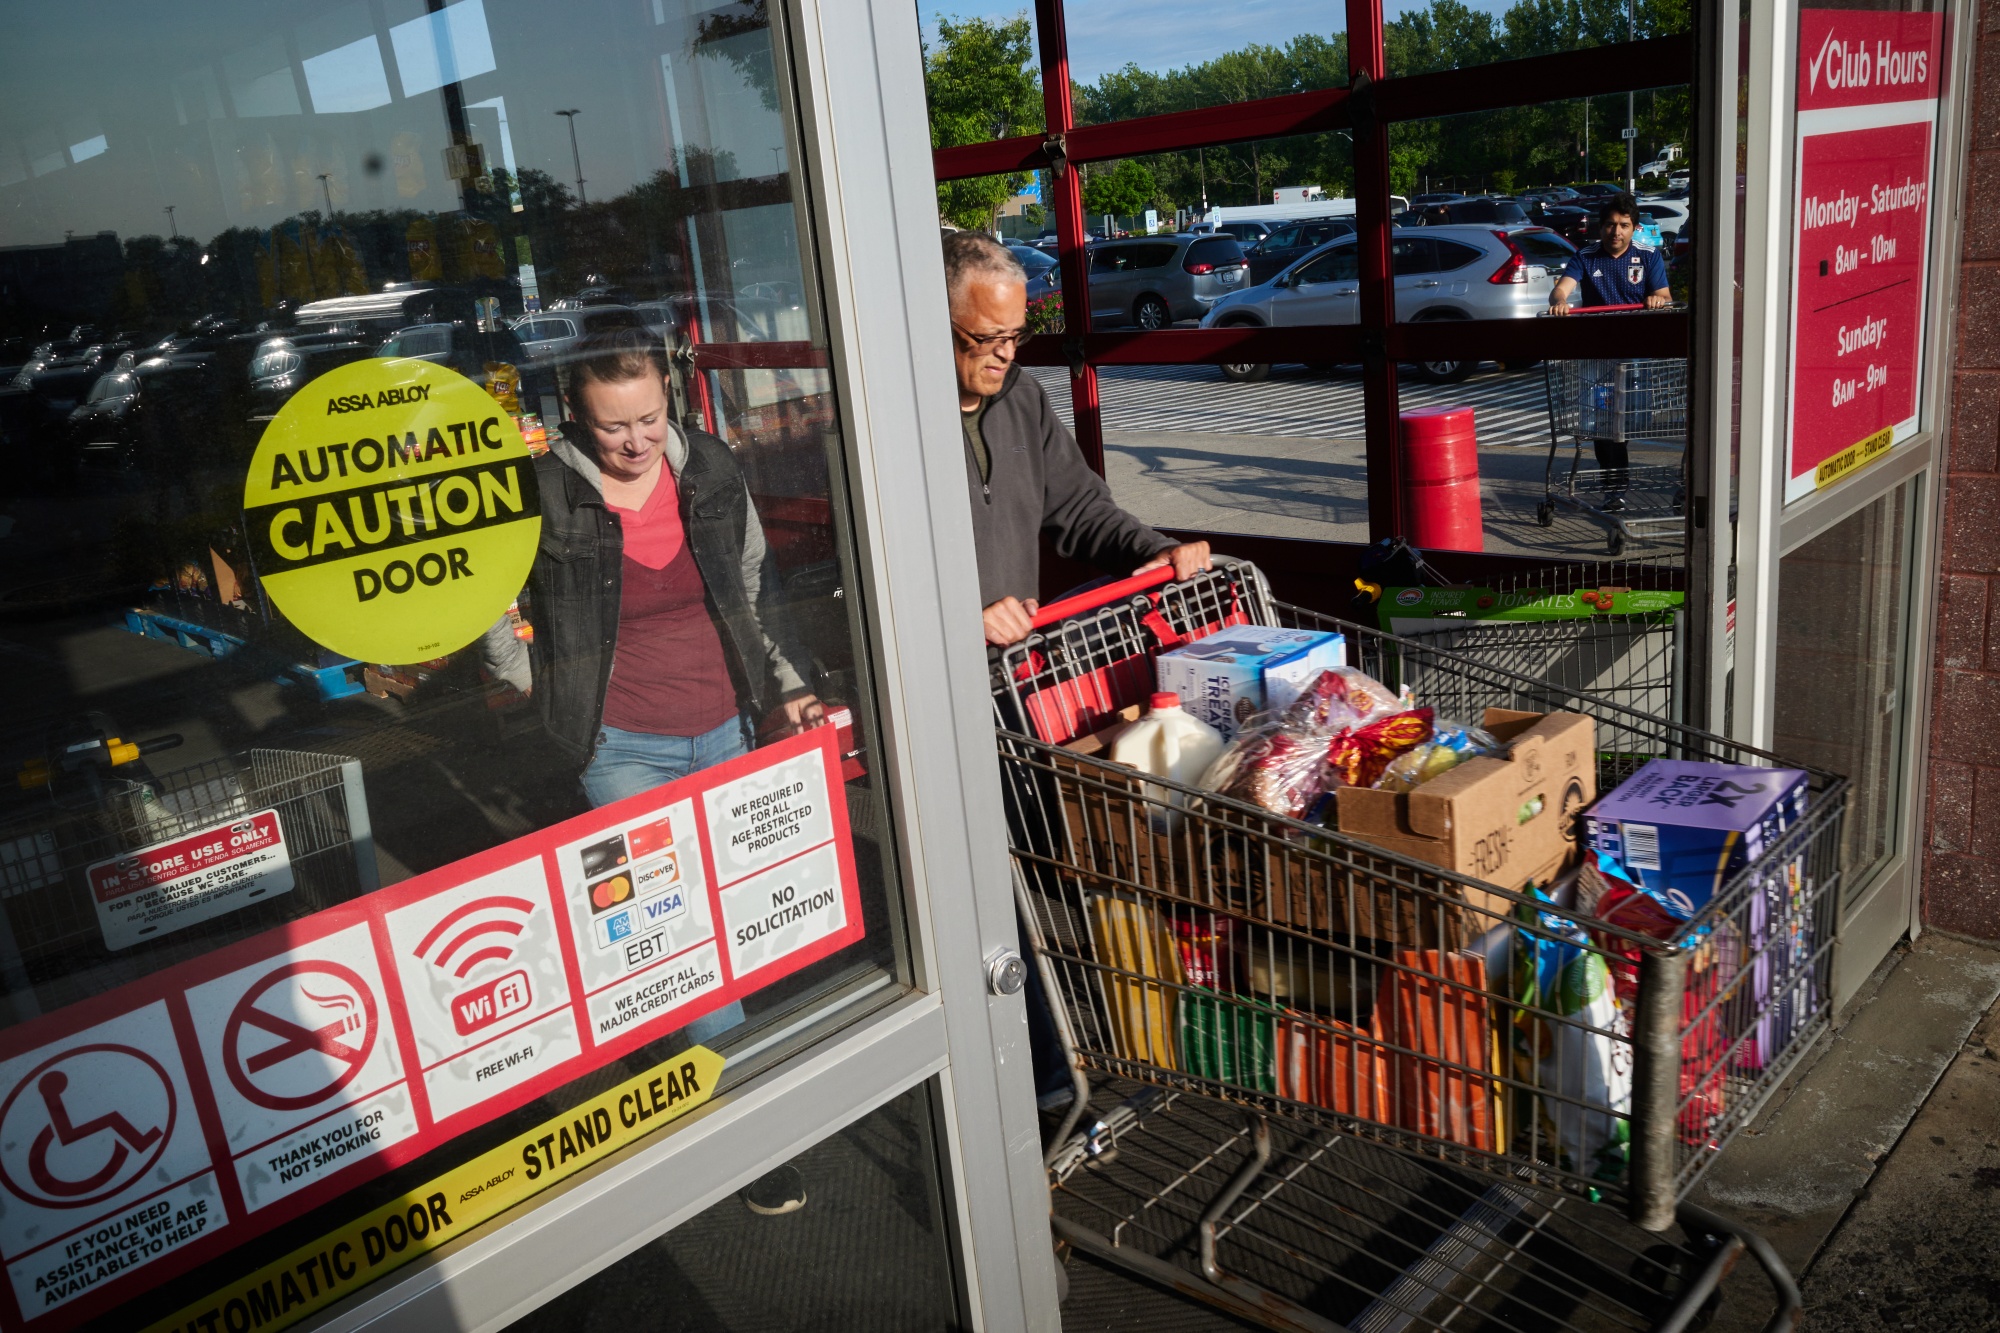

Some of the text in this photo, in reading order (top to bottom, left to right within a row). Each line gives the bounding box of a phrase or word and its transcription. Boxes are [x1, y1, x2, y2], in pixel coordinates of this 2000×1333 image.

[1826, 40, 1927, 89] Club Hours
[1804, 190, 1859, 230] Monday
[1871, 176, 1926, 214] Saturday:
[1835, 245, 1858, 275] 8AM
[1871, 235, 1896, 264] 10PM
[1838, 316, 1887, 356] Sunday:
[327, 384, 431, 416] ASSA ABLOY
[1832, 379, 1855, 408] 8AM
[1867, 364, 1887, 392] 9PM
[271, 417, 502, 490] AUTOMATIC
[269, 466, 524, 560] CAUTION
[353, 547, 474, 603] DOOR
[1497, 594, 1576, 608] TOMATES
[1208, 676, 1222, 732] TREAT
[1221, 676, 1230, 696] ICE
[732, 782, 804, 818] WE REQUIRE ID
[1675, 776, 1722, 807] LARGER
[1699, 780, 1768, 808] 2X
[732, 804, 812, 846] AGE-RESTRICTED
[750, 800, 790, 825] FOR ALL
[102, 826, 269, 889] IN-STORE USE ONLY
[748, 823, 800, 853] PRODUCTS
[148, 869, 177, 884] DENTRO
[180, 865, 190, 873] DE
[192, 861, 202, 869] LA
[204, 852, 229, 865] TIENDA
[231, 837, 273, 855] SOLAMENTE
[638, 864, 674, 884] DISCOVER
[109, 900, 132, 912] FOR
[136, 891, 158, 904] OUR
[162, 877, 202, 894] VALUED
[127, 911, 146, 922] PARA
[149, 898, 187, 916] NUESTROS
[189, 886, 229, 903] ESTIMADOS
[144, 881, 255, 924] PORQUE USTED ES IMPORTANTE
[145, 888, 194, 909] BECAUSE
[198, 880, 214, 891] WE
[644, 894, 682, 918] VISA
[772, 886, 795, 908] NO
[612, 915, 629, 928] AM
[616, 923, 631, 936] EX
[736, 888, 835, 947] SOLICITATION
[626, 932, 664, 966] EBT
[600, 971, 715, 1034] MAJOR CREDIT CARDS
[616, 967, 697, 1012] WE ACCEPT ALL
[476, 1046, 534, 1082] FREE Wi-Fi
[269, 1110, 383, 1172] THANK YOU FOR
[280, 1128, 381, 1184] NOT SMOKING
[171, 1061, 700, 1333] TOMATIC DOOR ASSA ABLOY STAND CLEAR
[34, 1200, 208, 1293] ASSISTANCE, WE ARE
[66, 1200, 171, 1259] IF YOU NEED
[44, 1217, 208, 1306] AVAILABLE TO HELP
